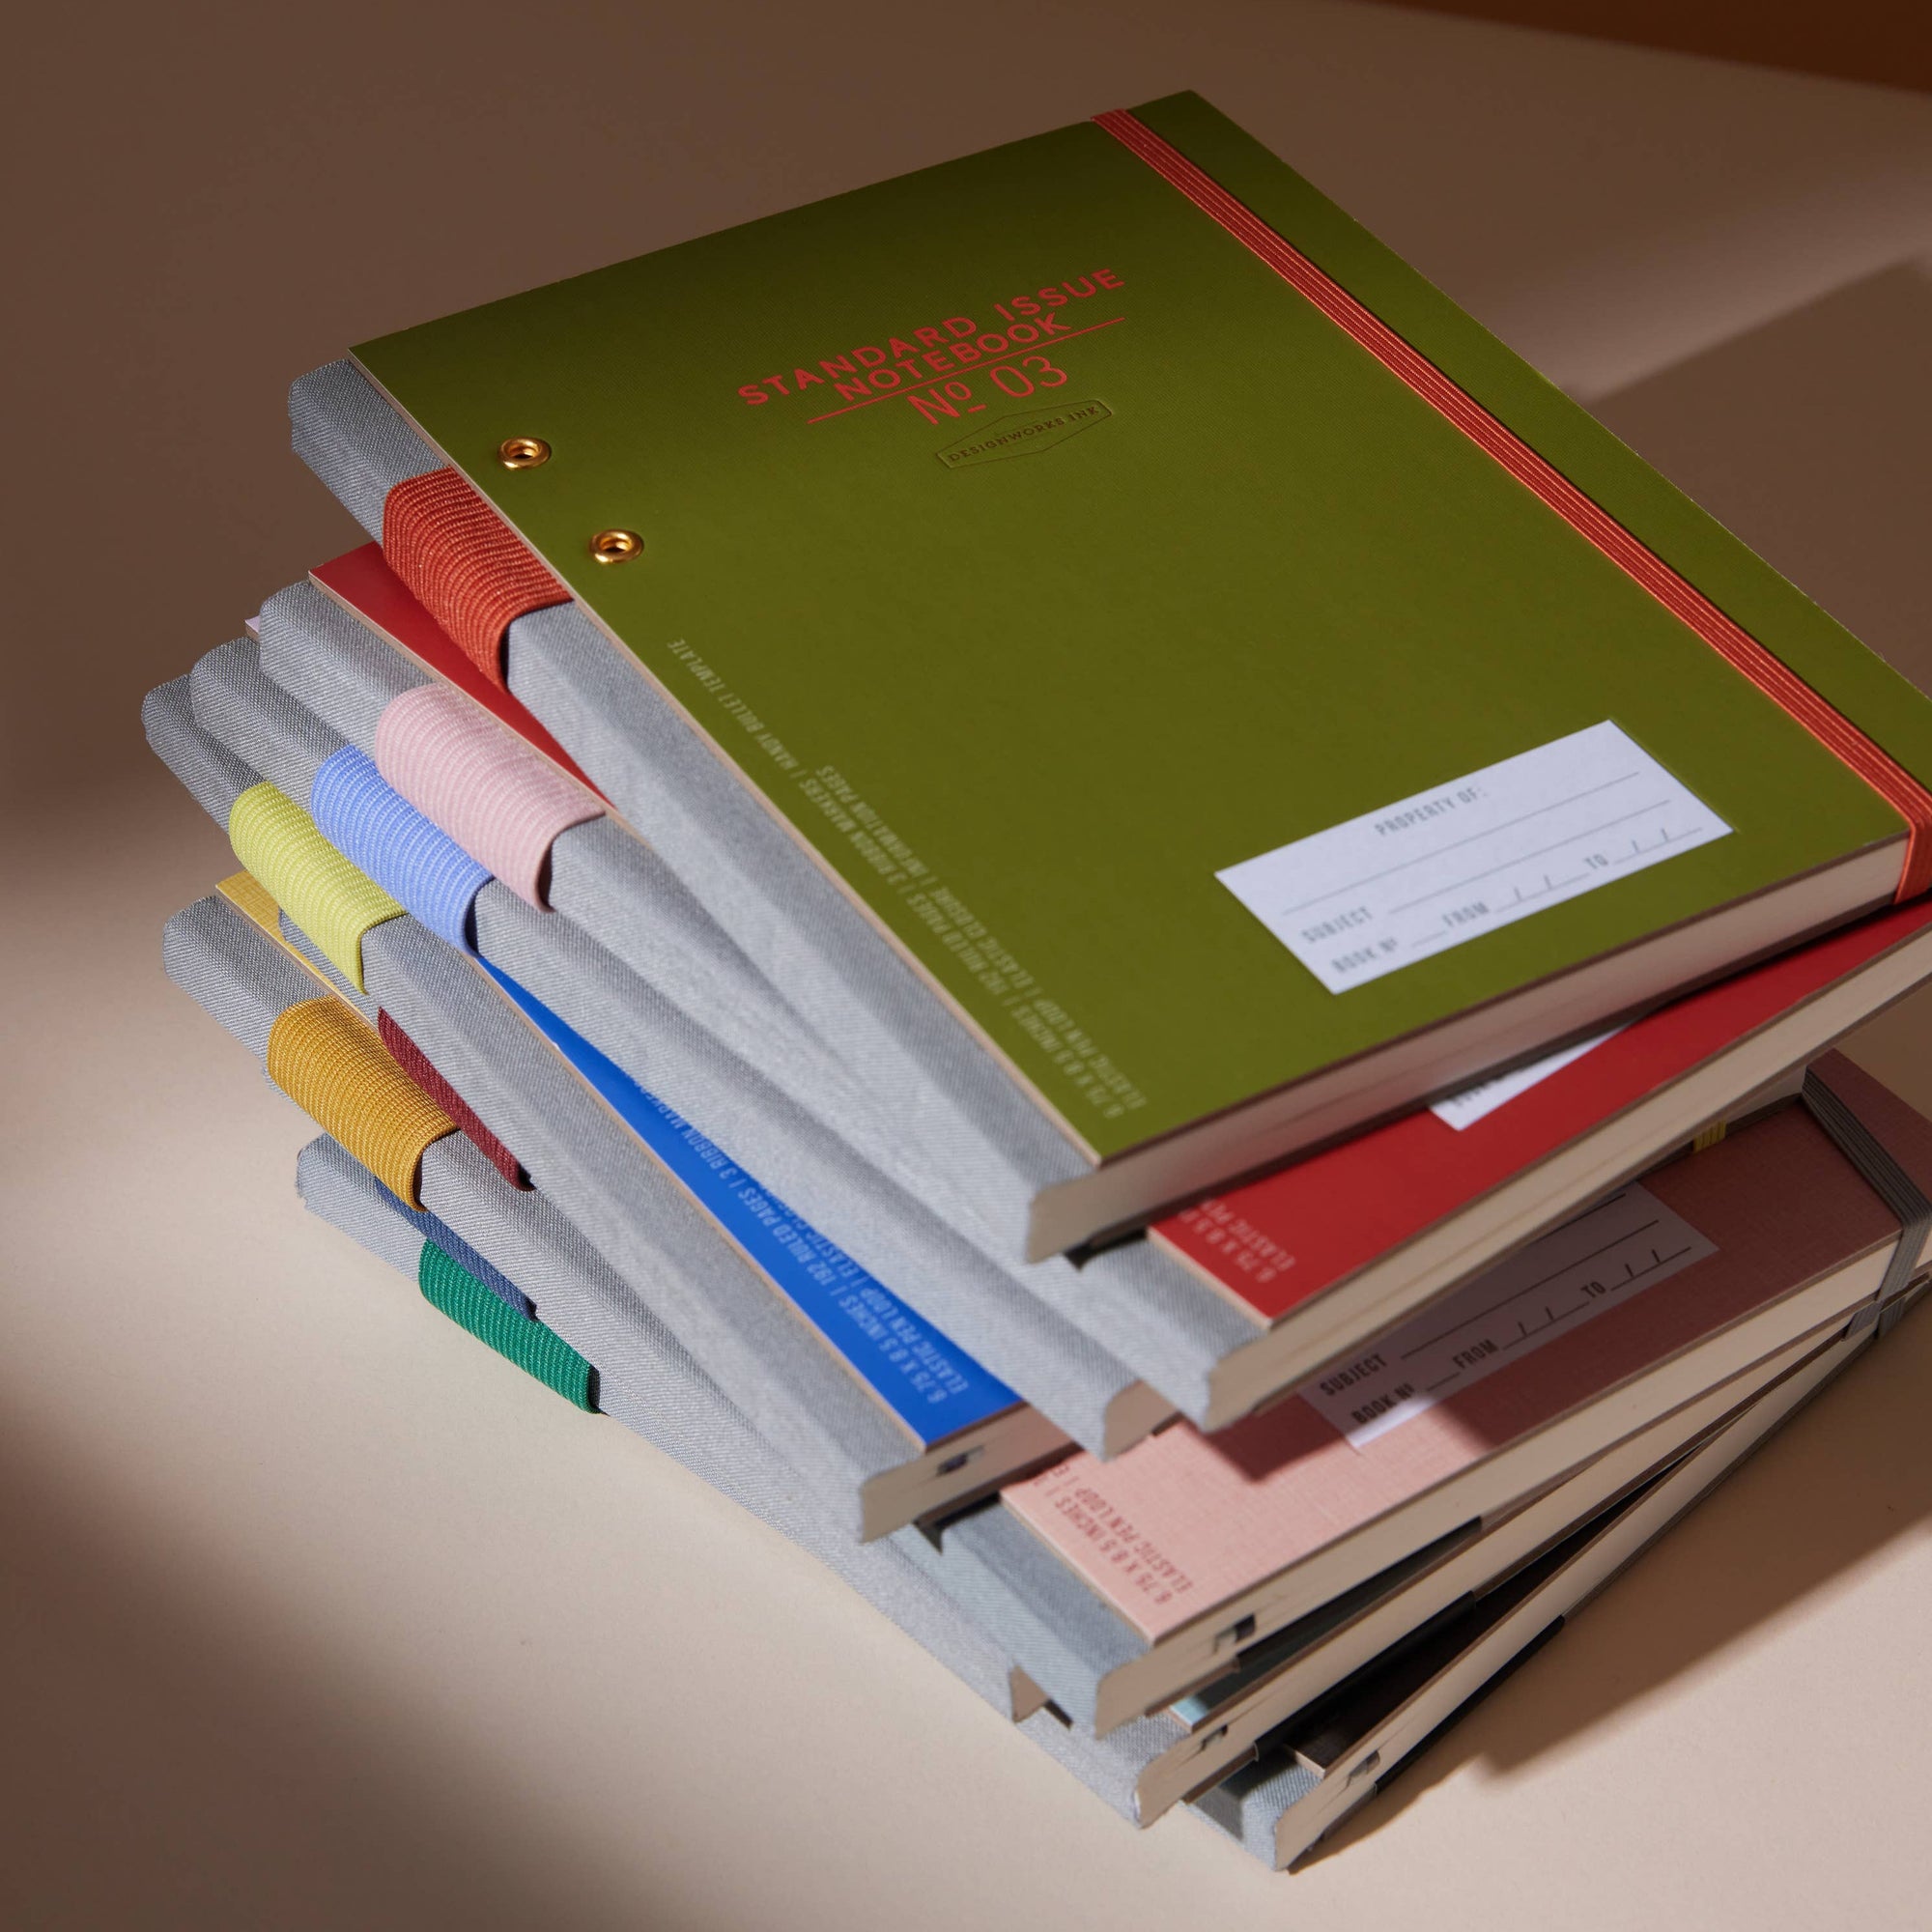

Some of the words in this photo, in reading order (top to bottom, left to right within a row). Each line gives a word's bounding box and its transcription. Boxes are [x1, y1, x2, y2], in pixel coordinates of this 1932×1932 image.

[738, 317, 977, 405] STANDARD
[994, 269, 1124, 322] ISSUE
[834, 312, 1071, 401] NOTEBOOK
[989, 355, 1067, 398] 03
[948, 417, 1065, 462] DESIGNWORKS
[668, 639, 724, 691] TEMPLATE
[719, 694, 763, 732] BULLET
[755, 733, 798, 769] HANDY
[817, 766, 859, 801] PAGES
[1374, 797, 1456, 836] PROPERTY
[1301, 905, 1374, 944] SUBJECT
[1331, 947, 1378, 974] BOOK
[1441, 901, 1490, 928] FROM
[1584, 853, 1609, 870] TO
[683, 1129, 726, 1167] RIBBON
[739, 1189, 780, 1223] PAGES
[774, 1227, 814, 1261] RULED
[808, 1264, 836, 1283] 192
[838, 1297, 888, 1339] INCHES
[860, 1287, 899, 1318] LOOP
[890, 1319, 921, 1342] PEN
[913, 1343, 969, 1391] ELASTIC
[1350, 1394, 1398, 1425] BOOK
[1453, 1339, 1498, 1369] FROM
[1580, 1281, 1606, 1300] TO
[1320, 1354, 1387, 1396] SUBJECT
[1056, 1496, 1106, 1540] INCHES
[1076, 1486, 1114, 1517] LOOP
[1108, 1517, 1139, 1542] PEN
[1134, 1543, 1191, 1592] ELASTIC
